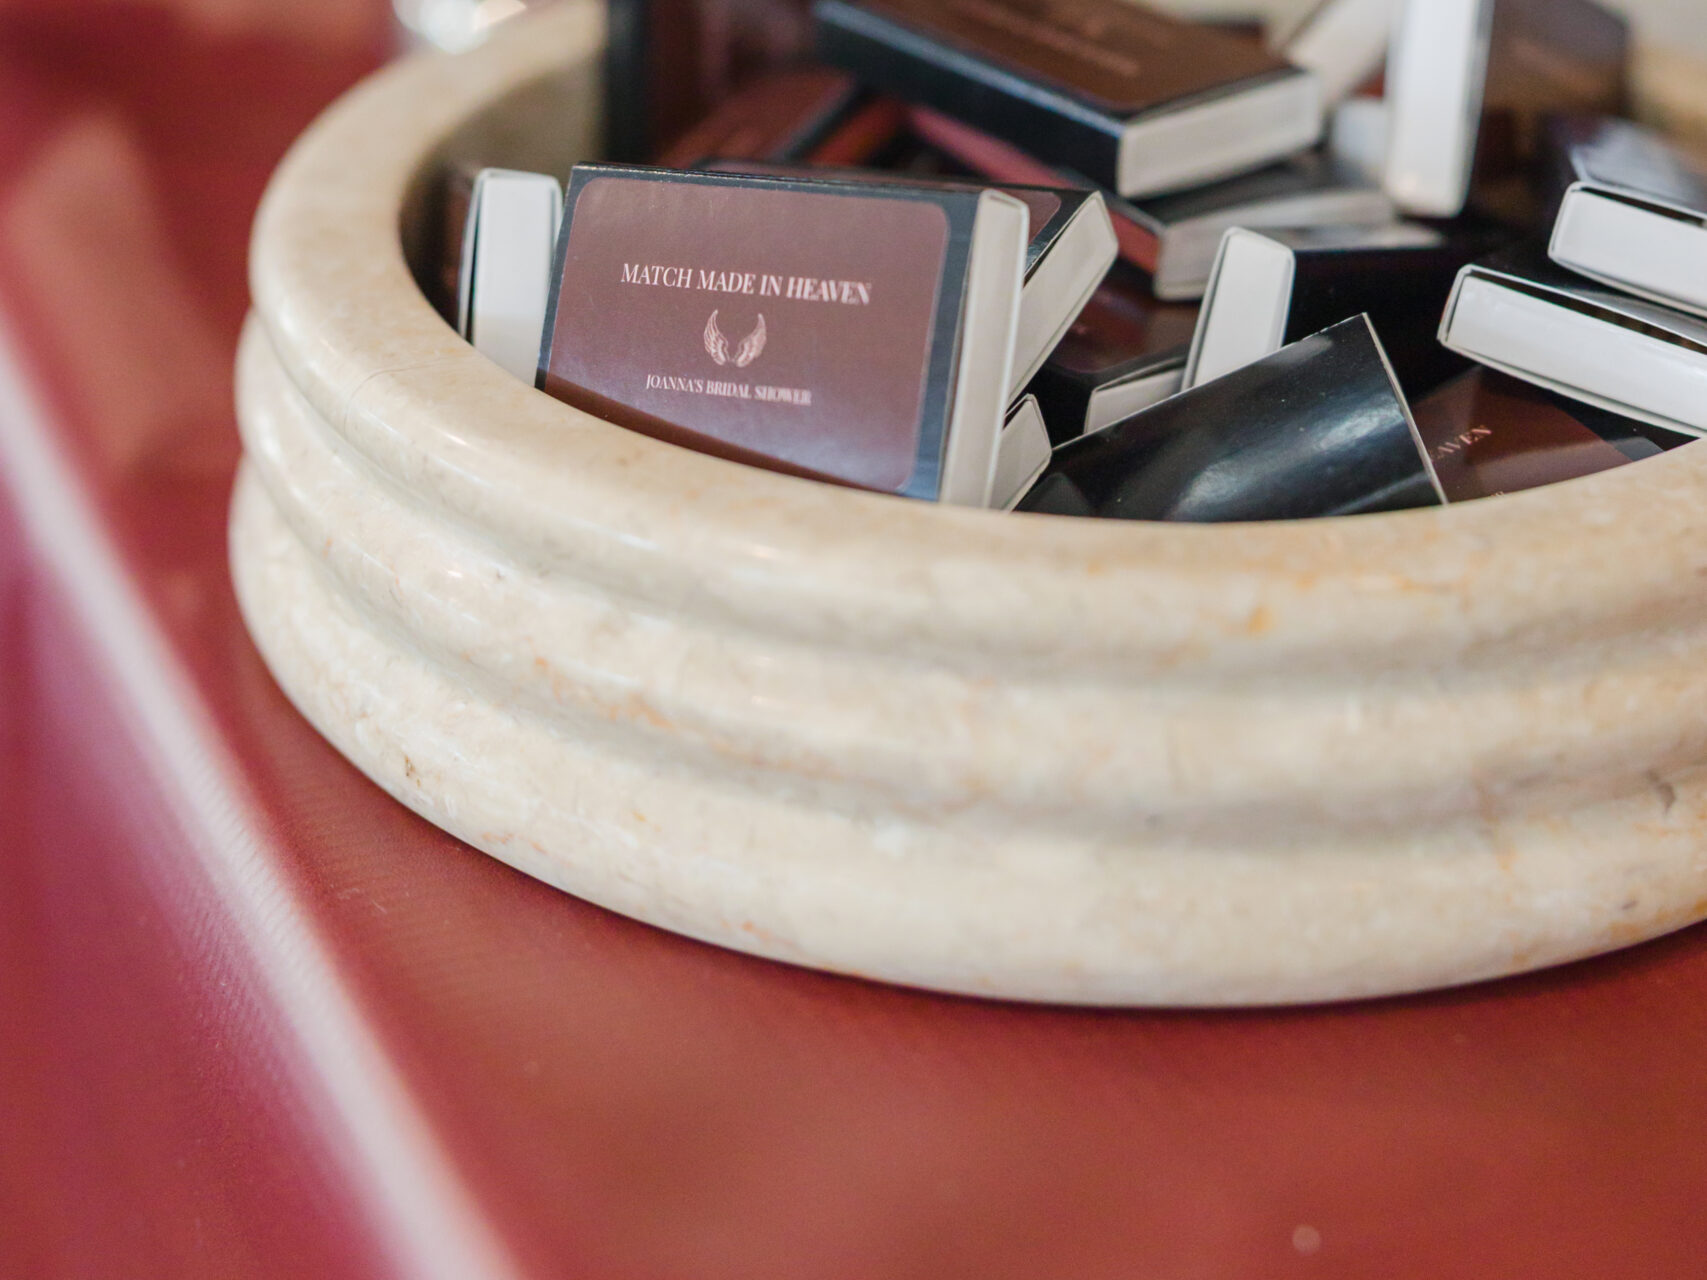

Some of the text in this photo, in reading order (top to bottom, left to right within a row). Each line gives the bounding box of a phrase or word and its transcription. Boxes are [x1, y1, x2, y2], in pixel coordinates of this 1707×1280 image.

[621, 263, 871, 304] MATCH MADE IN HEAVEN
[645, 374, 812, 405] JOANNA'S BRIDAL SHOWER
